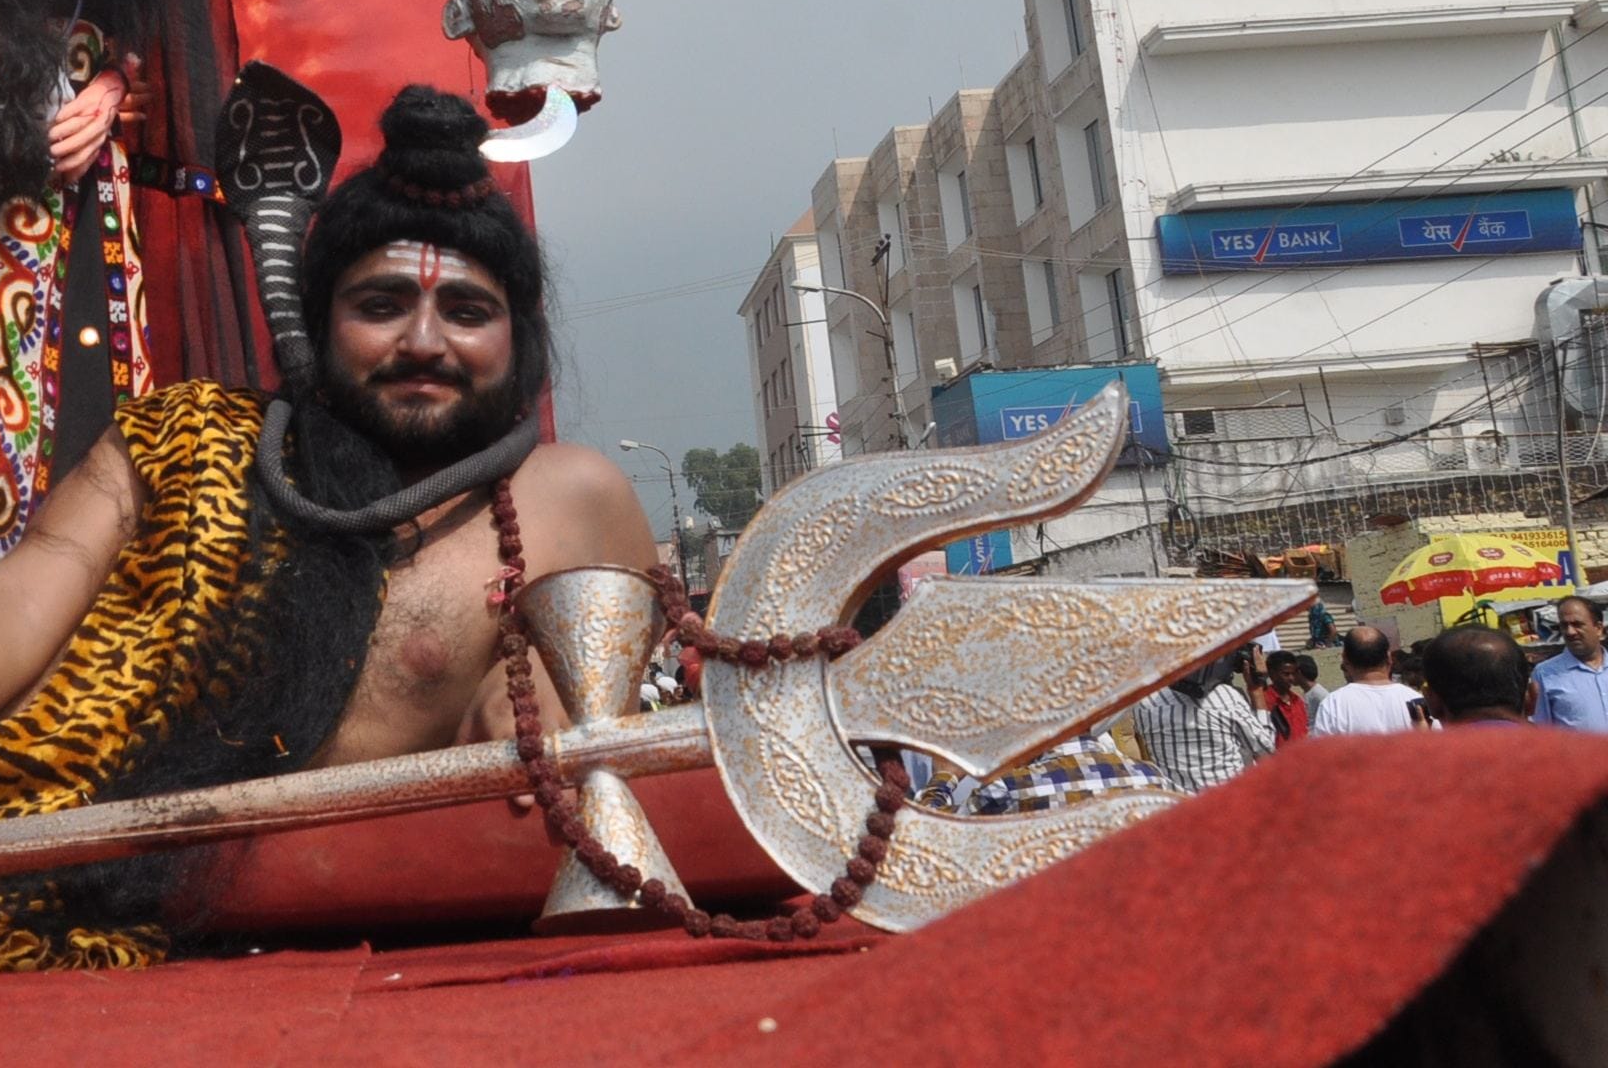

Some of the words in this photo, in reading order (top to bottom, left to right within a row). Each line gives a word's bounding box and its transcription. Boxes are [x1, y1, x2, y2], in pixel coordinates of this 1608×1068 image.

[1422, 220, 1451, 240] येस
[1219, 234, 1255, 251] YES
[1278, 230, 1333, 248] BANK
[1010, 414, 1049, 432] YES
[975, 533, 986, 563] ES
